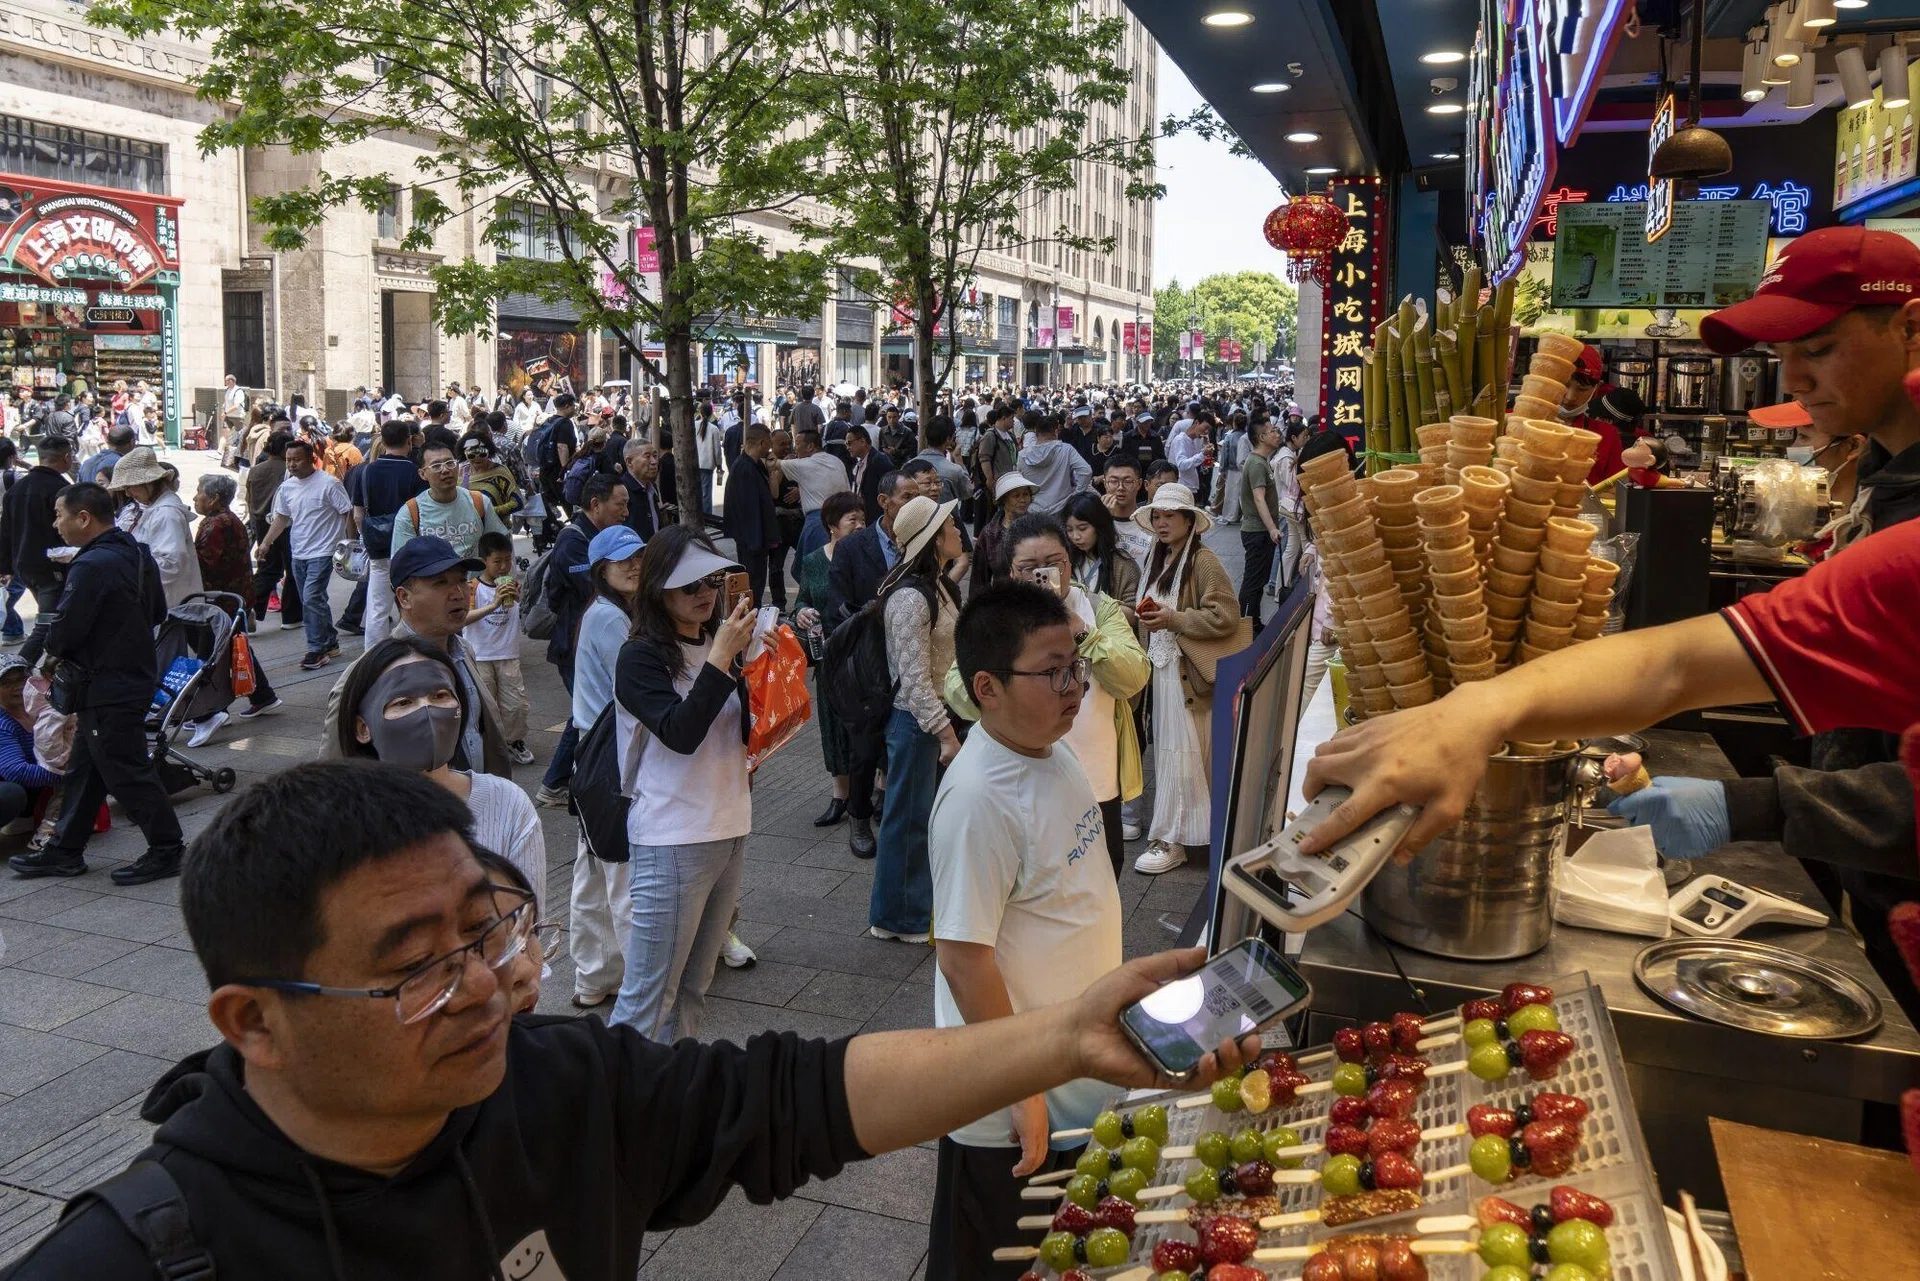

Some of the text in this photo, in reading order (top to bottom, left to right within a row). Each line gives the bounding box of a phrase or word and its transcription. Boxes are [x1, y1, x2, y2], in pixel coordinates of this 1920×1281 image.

[38, 198, 75, 215] SHANGHAI
[76, 197, 122, 216] WENCHUANG
[26, 214, 155, 273] 上海文创市集
[1860, 280, 1913, 293] adidas
[164, 676, 180, 684] NICE
[1074, 805, 1099, 840] ANTA
